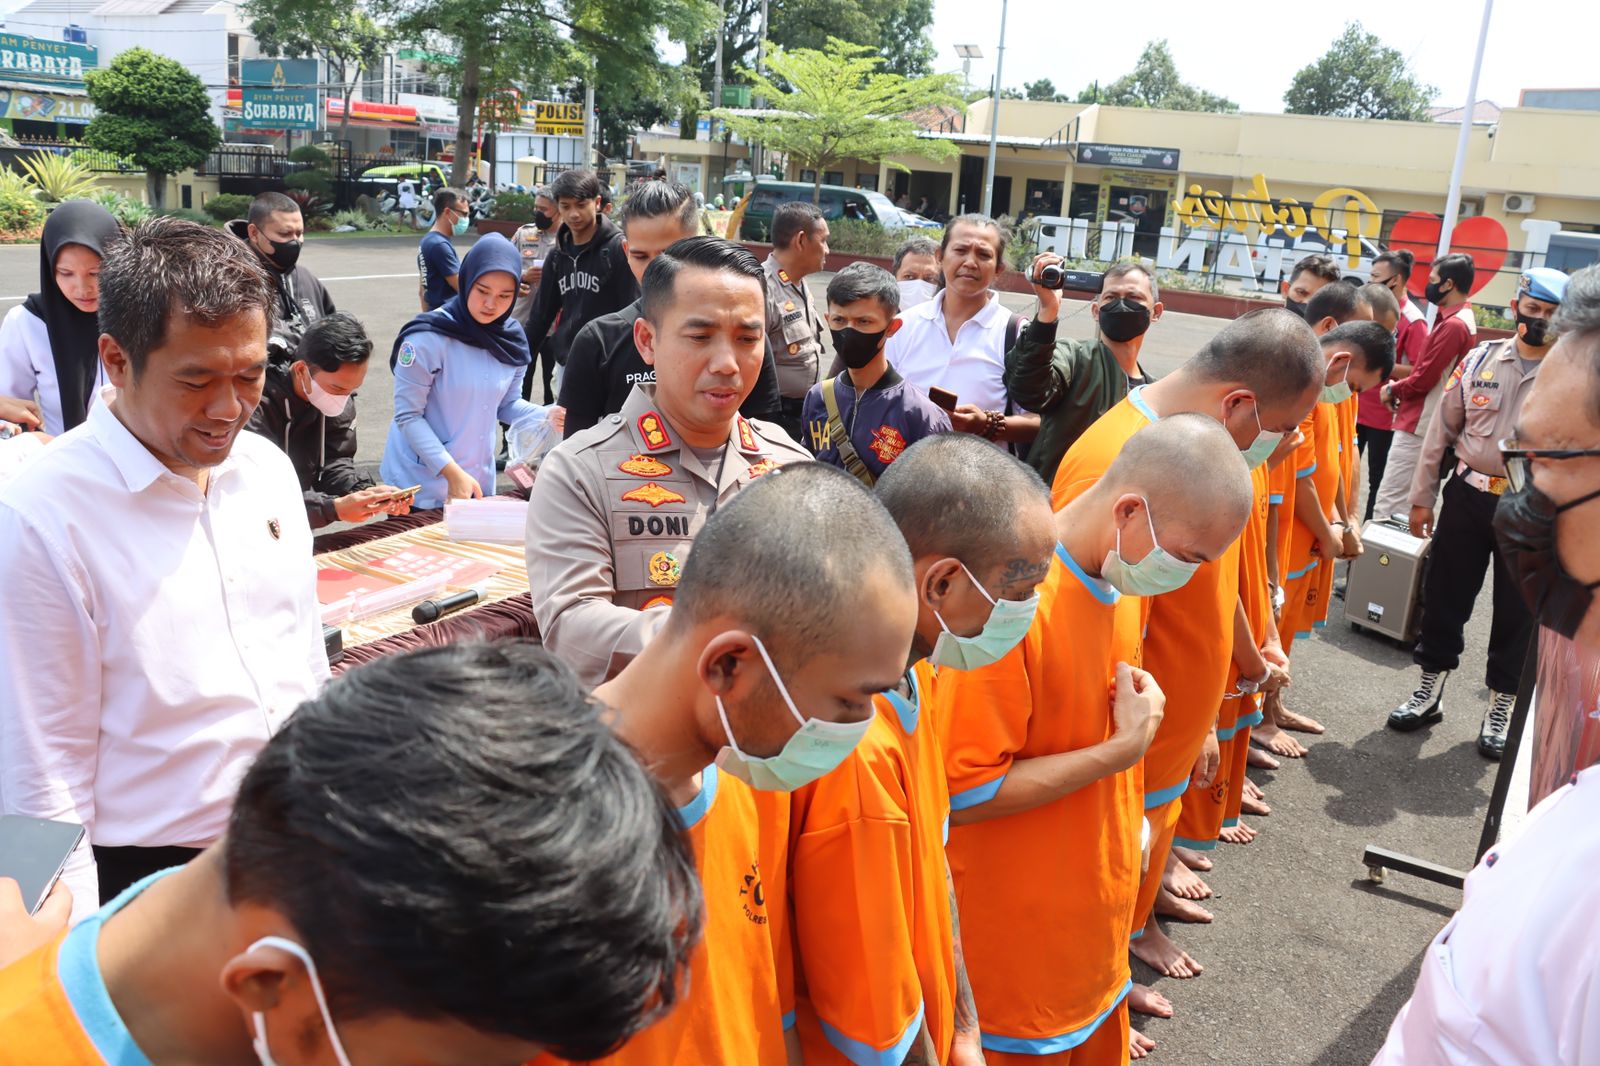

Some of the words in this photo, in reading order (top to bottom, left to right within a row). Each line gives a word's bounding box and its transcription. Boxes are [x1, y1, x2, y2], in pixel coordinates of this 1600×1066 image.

[22, 39, 68, 54] PENYET
[244, 101, 315, 122] SURABAYA
[536, 103, 583, 121] POLISI
[628, 515, 689, 536] DONI
[742, 903, 768, 925] POLRES
